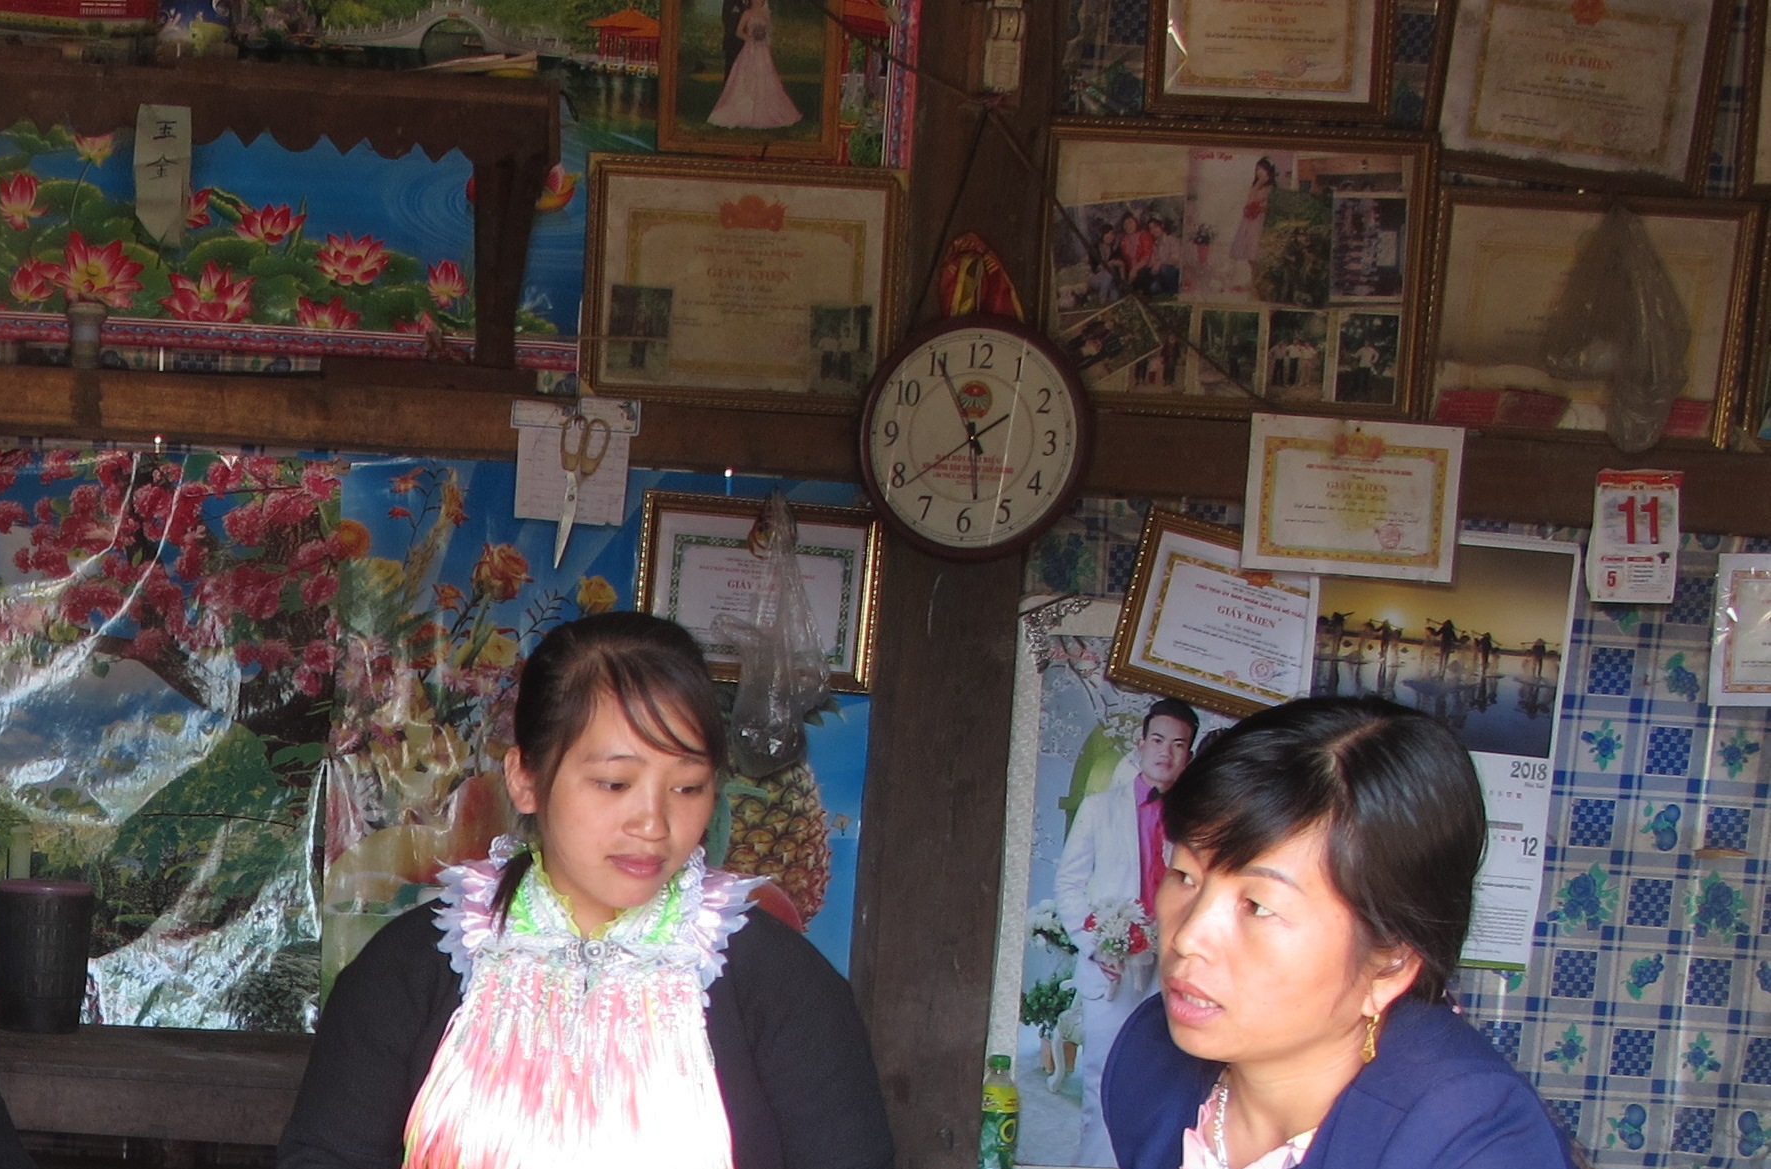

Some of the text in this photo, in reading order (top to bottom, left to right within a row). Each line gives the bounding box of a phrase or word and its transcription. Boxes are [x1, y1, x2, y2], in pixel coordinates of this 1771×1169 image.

[1578, 55, 1613, 70] KHEN
[748, 270, 791, 282] KHEN
[928, 351, 948, 377] 11
[968, 343, 994, 369] 12
[1014, 357, 1023, 382] 1
[896, 380, 921, 406] 10
[1036, 388, 1052, 414] 2
[884, 421, 899, 447] 9
[1042, 430, 1056, 456] 3
[891, 462, 906, 488] 8
[1027, 470, 1042, 496] 4
[918, 495, 933, 521] 7
[956, 507, 971, 533] 6
[997, 498, 1012, 524] 5
[1616, 495, 1659, 545] 11
[1606, 570, 1618, 587] 5
[1217, 604, 1277, 629] GIẤY KHEN
[1510, 760, 1547, 781] 2018
[1521, 837, 1538, 856] 12
